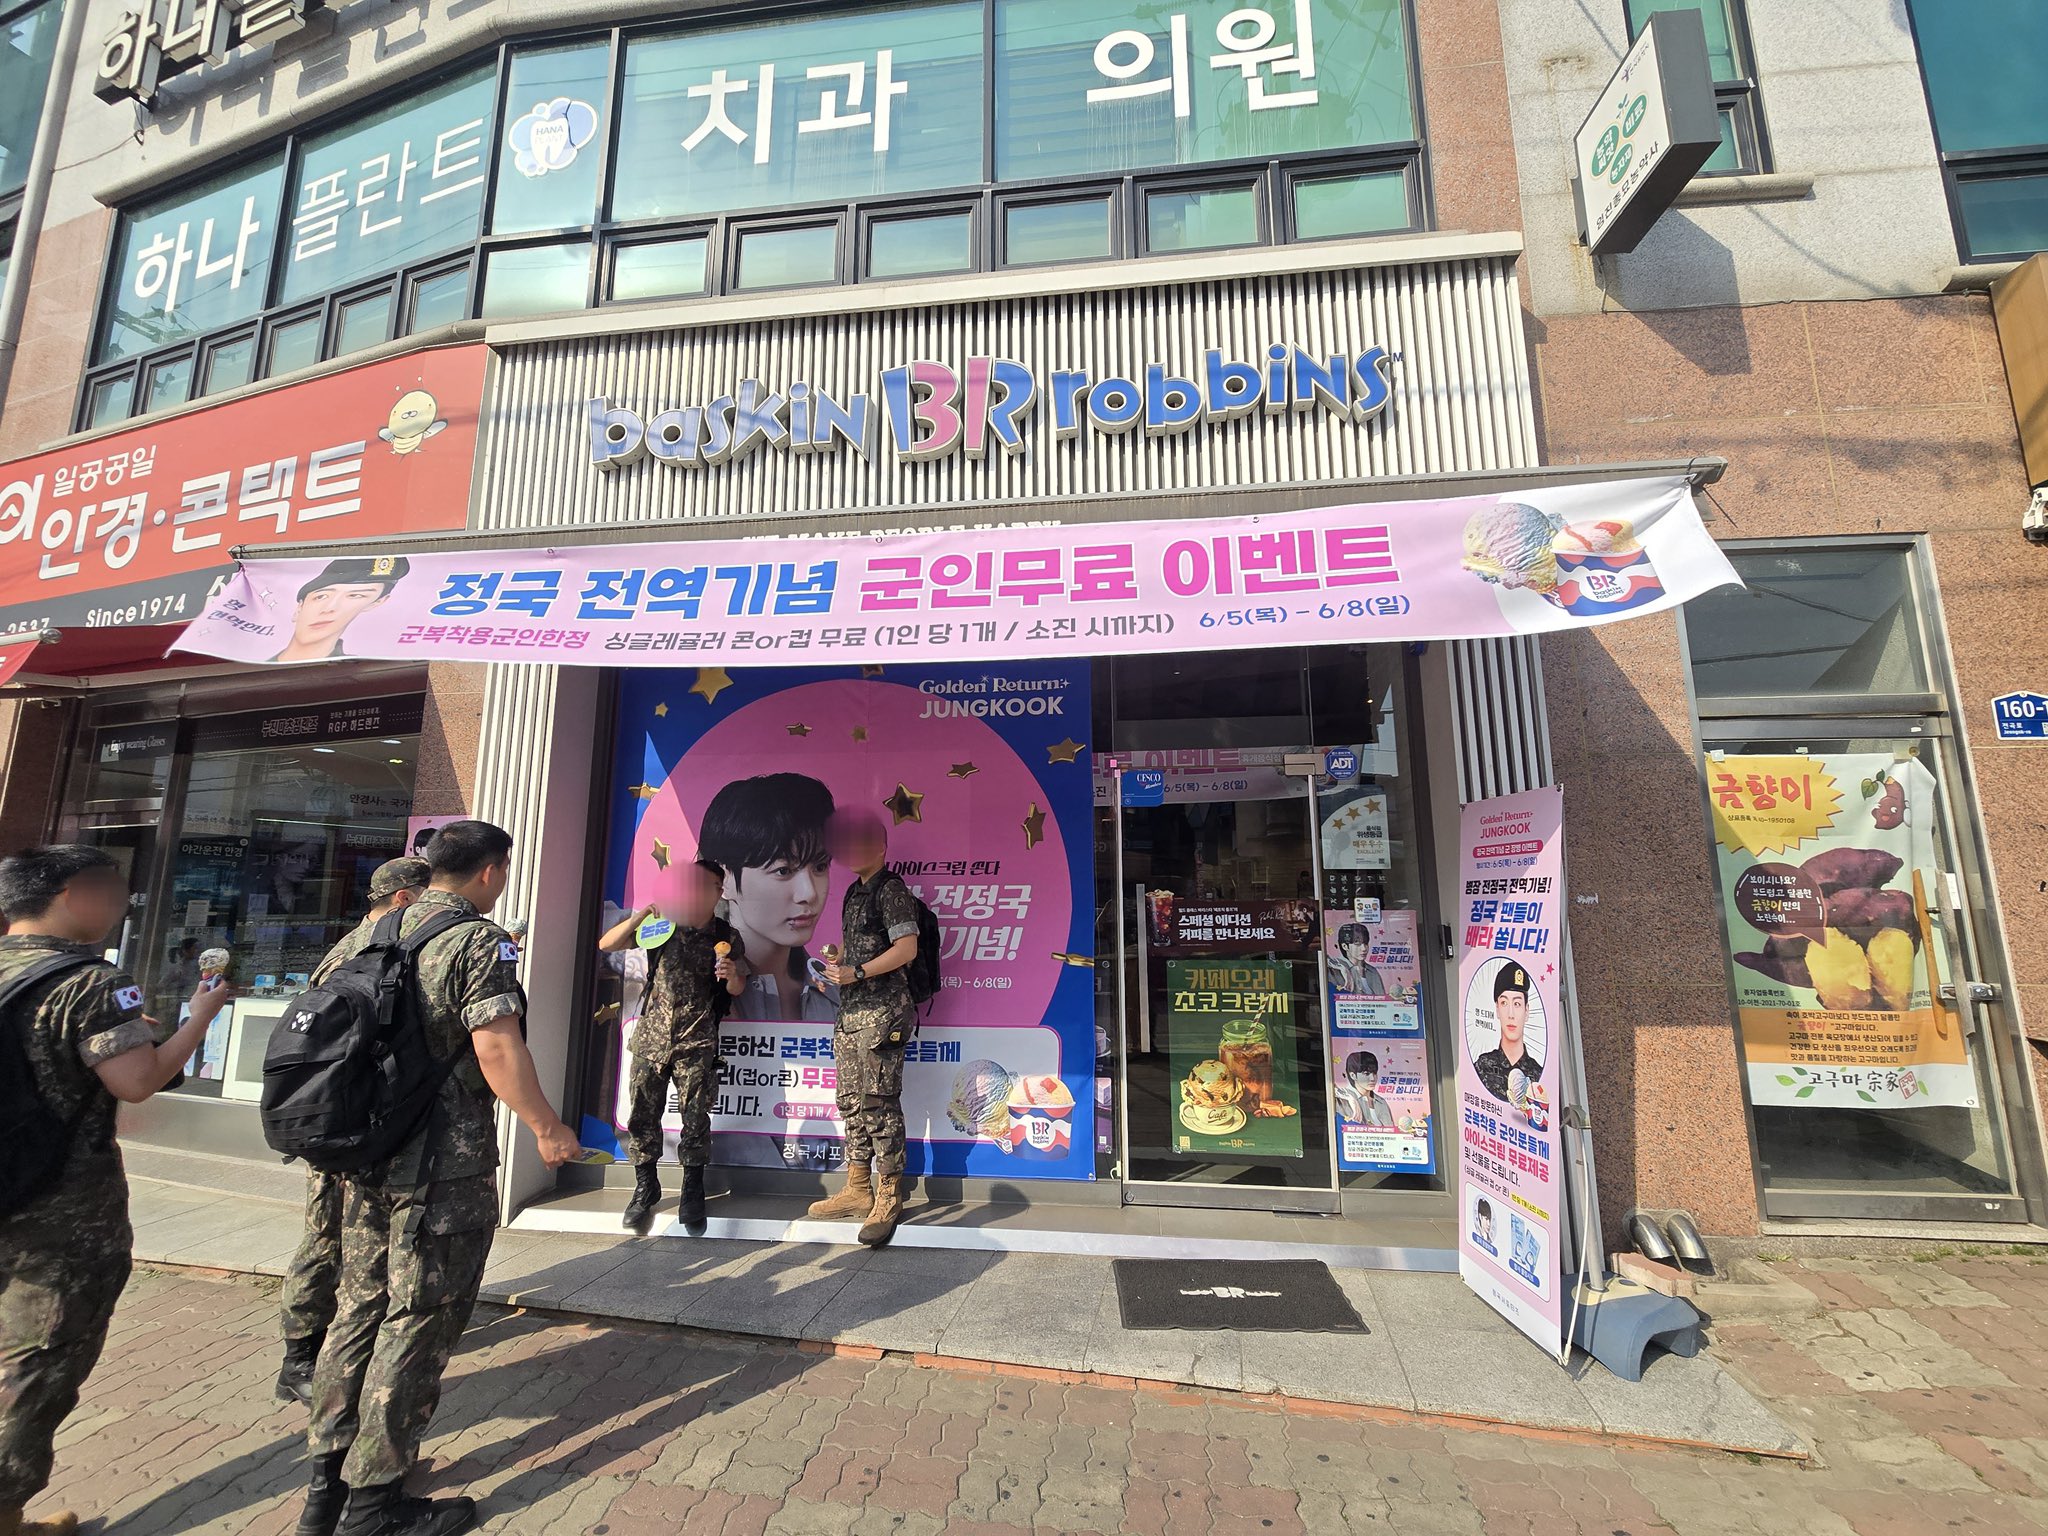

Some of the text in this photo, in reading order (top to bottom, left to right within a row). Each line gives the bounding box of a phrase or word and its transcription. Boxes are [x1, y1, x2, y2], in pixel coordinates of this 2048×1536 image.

[681, 0, 1319, 164] 치과 의원
[1625, 100, 1644, 133] 비료
[536, 125, 564, 136] HANA
[135, 118, 486, 313] 하나 플란트
[590, 342, 1391, 471] baskin BR robbins
[52, 445, 157, 498] 일공공일
[429, 524, 1402, 620] 정국 전역기념 군인무료 이벤트
[1586, 574, 1617, 591] BR
[86, 594, 187, 628] Since1974
[399, 594, 1412, 652] 군복착용군인한정 싱글레귤러 콘or컵 무료 (1인 당 1개 / 소진 시까지) 6/5(목) 6/8(일)
[919, 677, 1056, 696] Golden Return
[919, 696, 1064, 719] JUNGKOOK
[261, 716, 319, 738] 누진다초점렌즈
[1331, 757, 1354, 769] ADT
[1136, 773, 1161, 782] CESCO
[1164, 779, 1248, 793] 6/5(목) 6/8(일)
[1712, 774, 1812, 811] 금향이
[1480, 811, 1529, 826] Golden Return
[1728, 814, 1752, 822] 상표등록
[1480, 822, 1531, 839] JUNGKOOK
[182, 844, 244, 858] 야간운전 안경
[969, 861, 1001, 876] 쏜다
[1465, 876, 1552, 895] 병장 전정국 전역기념!
[1750, 875, 1797, 885] 보이시나요?
[930, 884, 1032, 920] 전정국
[1752, 888, 1812, 898] 부드럽고 달콤한
[1470, 900, 1543, 924] 정국 팬들이
[1751, 899, 1801, 912] 금향이만의
[1178, 914, 1214, 927] 스페셜
[1214, 913, 1252, 926] 에디션
[1179, 927, 1276, 941] 커피를 만나보세요
[1464, 925, 1550, 954] 배라 쏩니다!
[939, 926, 1024, 961] 기념!
[973, 977, 1012, 989] 6/8(일)
[1185, 968, 1276, 990] 카페오레
[1174, 990, 1289, 1014] 초코크런치
[1801, 1012, 1850, 1021] 호박고구마보다
[1851, 1013, 1879, 1021] 부드럽고
[1788, 1032, 1810, 1041] 고구마
[1863, 1034, 1891, 1042] 생산되어
[719, 1037, 775, 1059] 문하신
[1790, 1042, 1811, 1051] 건강한
[1790, 1053, 1805, 1062] 맛과
[1828, 1054, 1857, 1063] 자랑하는
[802, 1067, 837, 1090] 무료
[1808, 1071, 1863, 1088] 고구마
[779, 1105, 795, 1118] 1인
[796, 1105, 807, 1118] 당
[808, 1105, 825, 1118] 1개
[1480, 1099, 1503, 1117] 방문하신
[1031, 1121, 1050, 1135] BR
[1464, 1107, 1550, 1161] 군복착용 군인분들께
[782, 1143, 842, 1161] 정국서포
[1231, 1139, 1244, 1148] BR
[1464, 1126, 1549, 1183] 아이스크림 무료제공
[1464, 1146, 1471, 1160] 및
[1491, 1161, 1521, 1187] 드립니다.
[1210, 1286, 1246, 1300] BR
